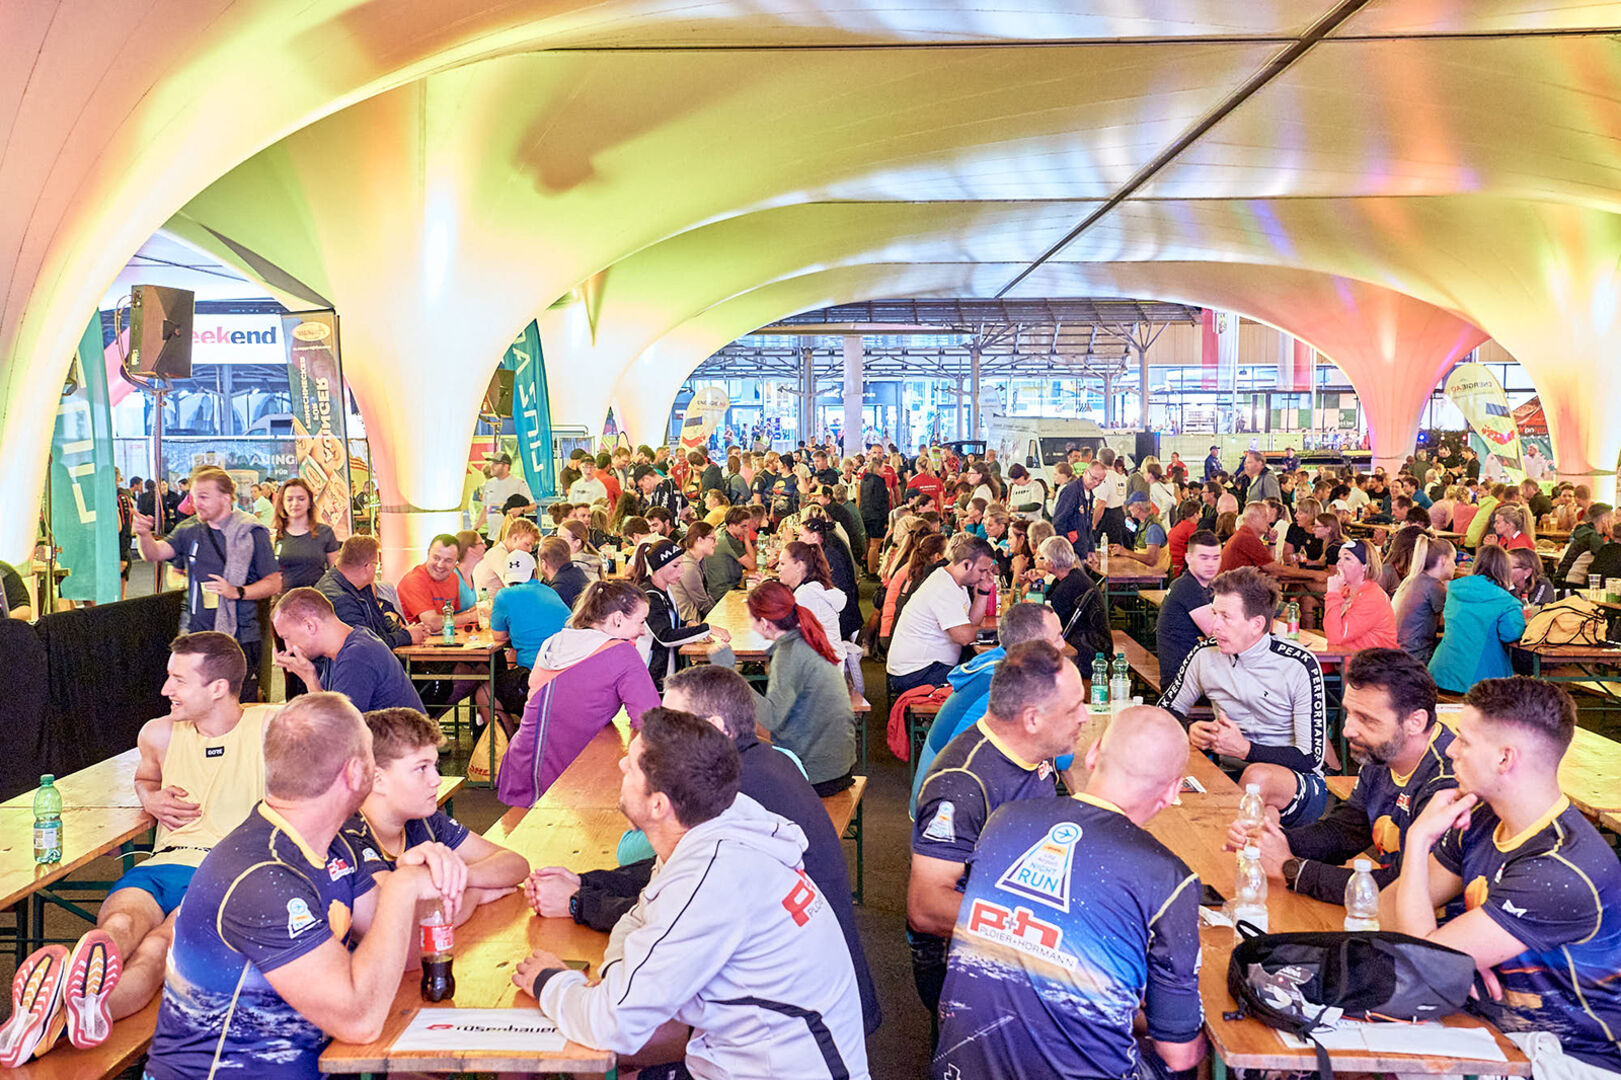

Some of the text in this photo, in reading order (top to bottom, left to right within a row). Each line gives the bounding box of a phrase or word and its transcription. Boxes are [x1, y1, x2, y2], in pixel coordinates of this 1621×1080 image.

[1277, 644, 1311, 662] PEAK
[1168, 637, 1218, 699] PERFORMANC
[1017, 867, 1059, 893] RUN
